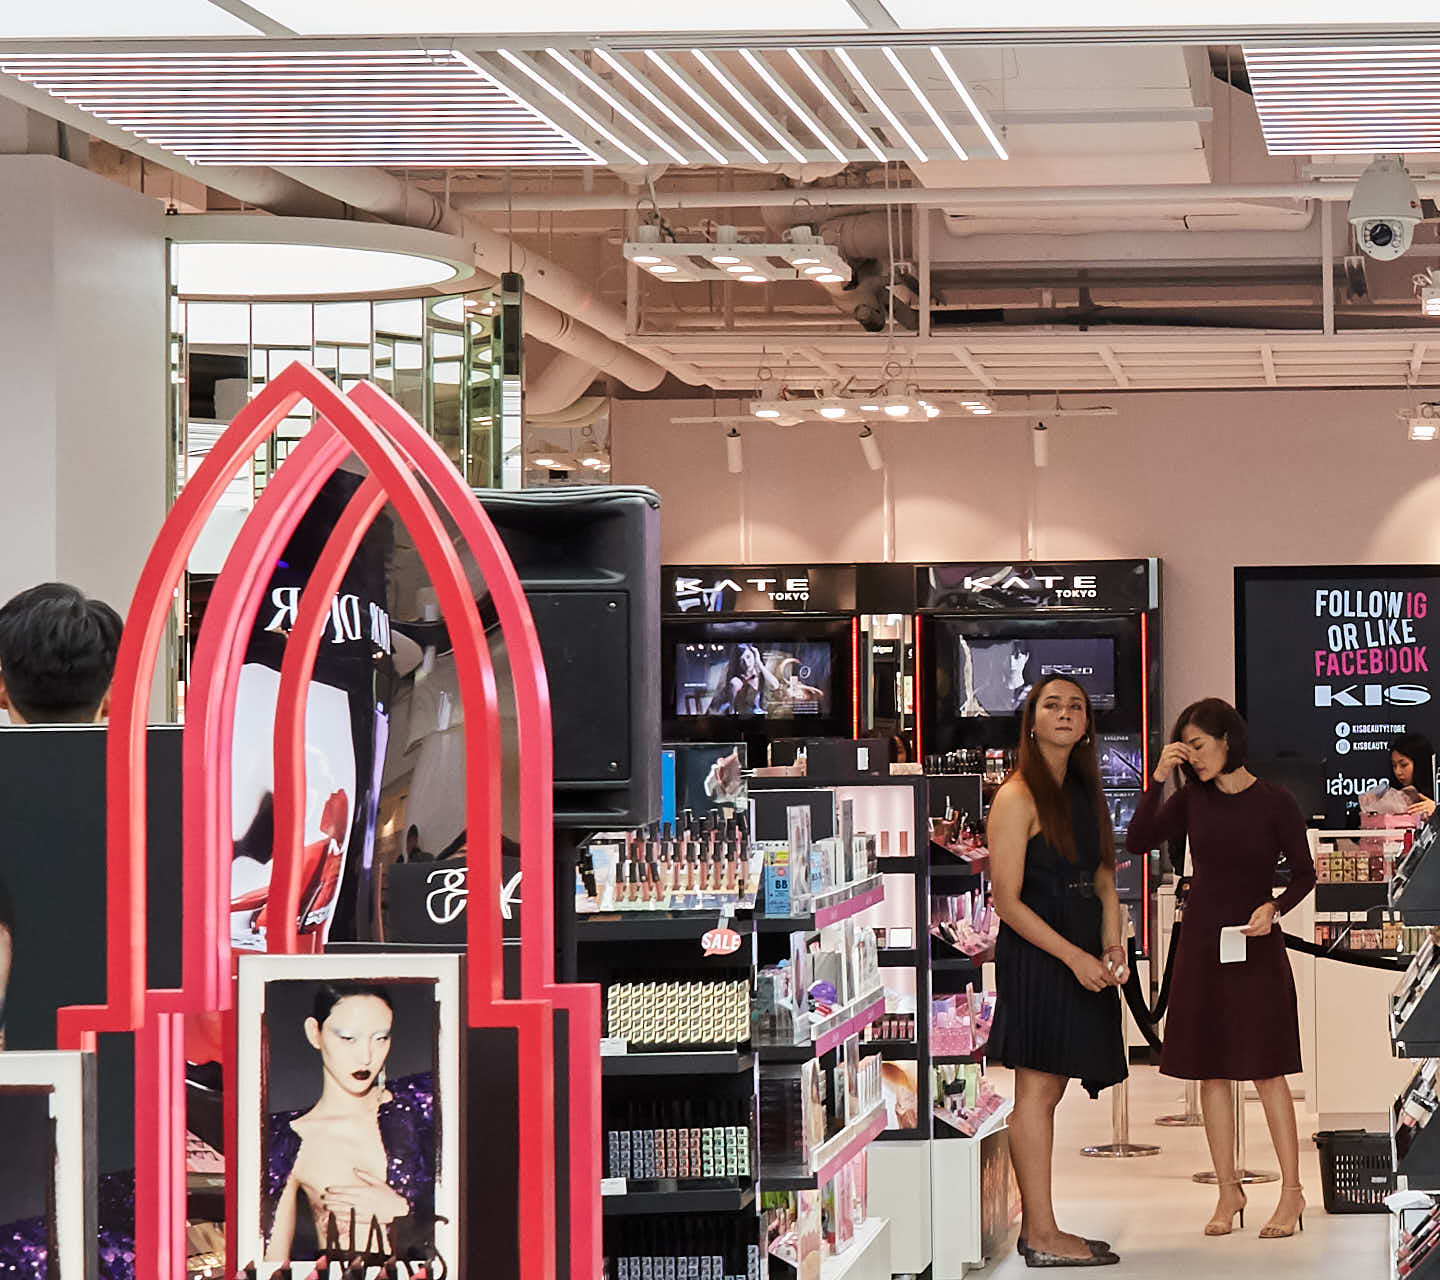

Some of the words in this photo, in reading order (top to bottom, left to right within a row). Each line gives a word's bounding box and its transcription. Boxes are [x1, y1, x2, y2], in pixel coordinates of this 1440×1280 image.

[675, 577, 810, 593] KATE
[963, 576, 1097, 590] KATE
[1056, 589, 1098, 599] TOKYO
[767, 592, 810, 602] TOKYO
[1315, 589, 1404, 619] FOLLOW
[1406, 591, 1428, 619] IG
[1327, 622, 1360, 653] OR
[1364, 618, 1417, 649] LIKE
[1314, 645, 1429, 678] FACEBOOK
[1314, 683, 1432, 707] KIS
[701, 930, 741, 952] SALE
